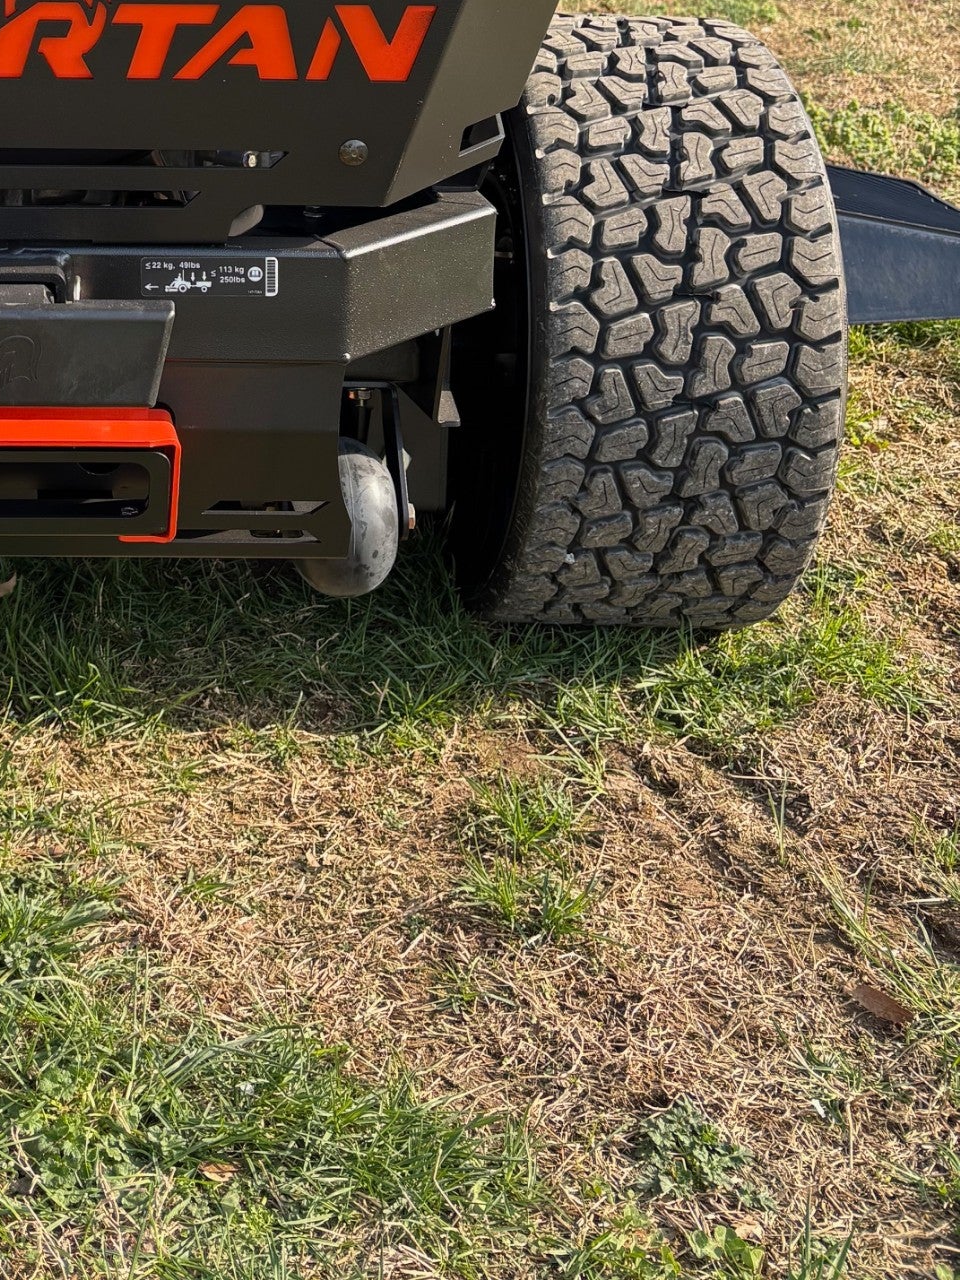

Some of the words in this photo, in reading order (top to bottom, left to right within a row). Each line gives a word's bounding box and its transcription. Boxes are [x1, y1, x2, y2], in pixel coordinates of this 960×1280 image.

[179, 261, 201, 269] 49lbs
[234, 266, 245, 275] kg
[219, 276, 246, 284] 250lbs
